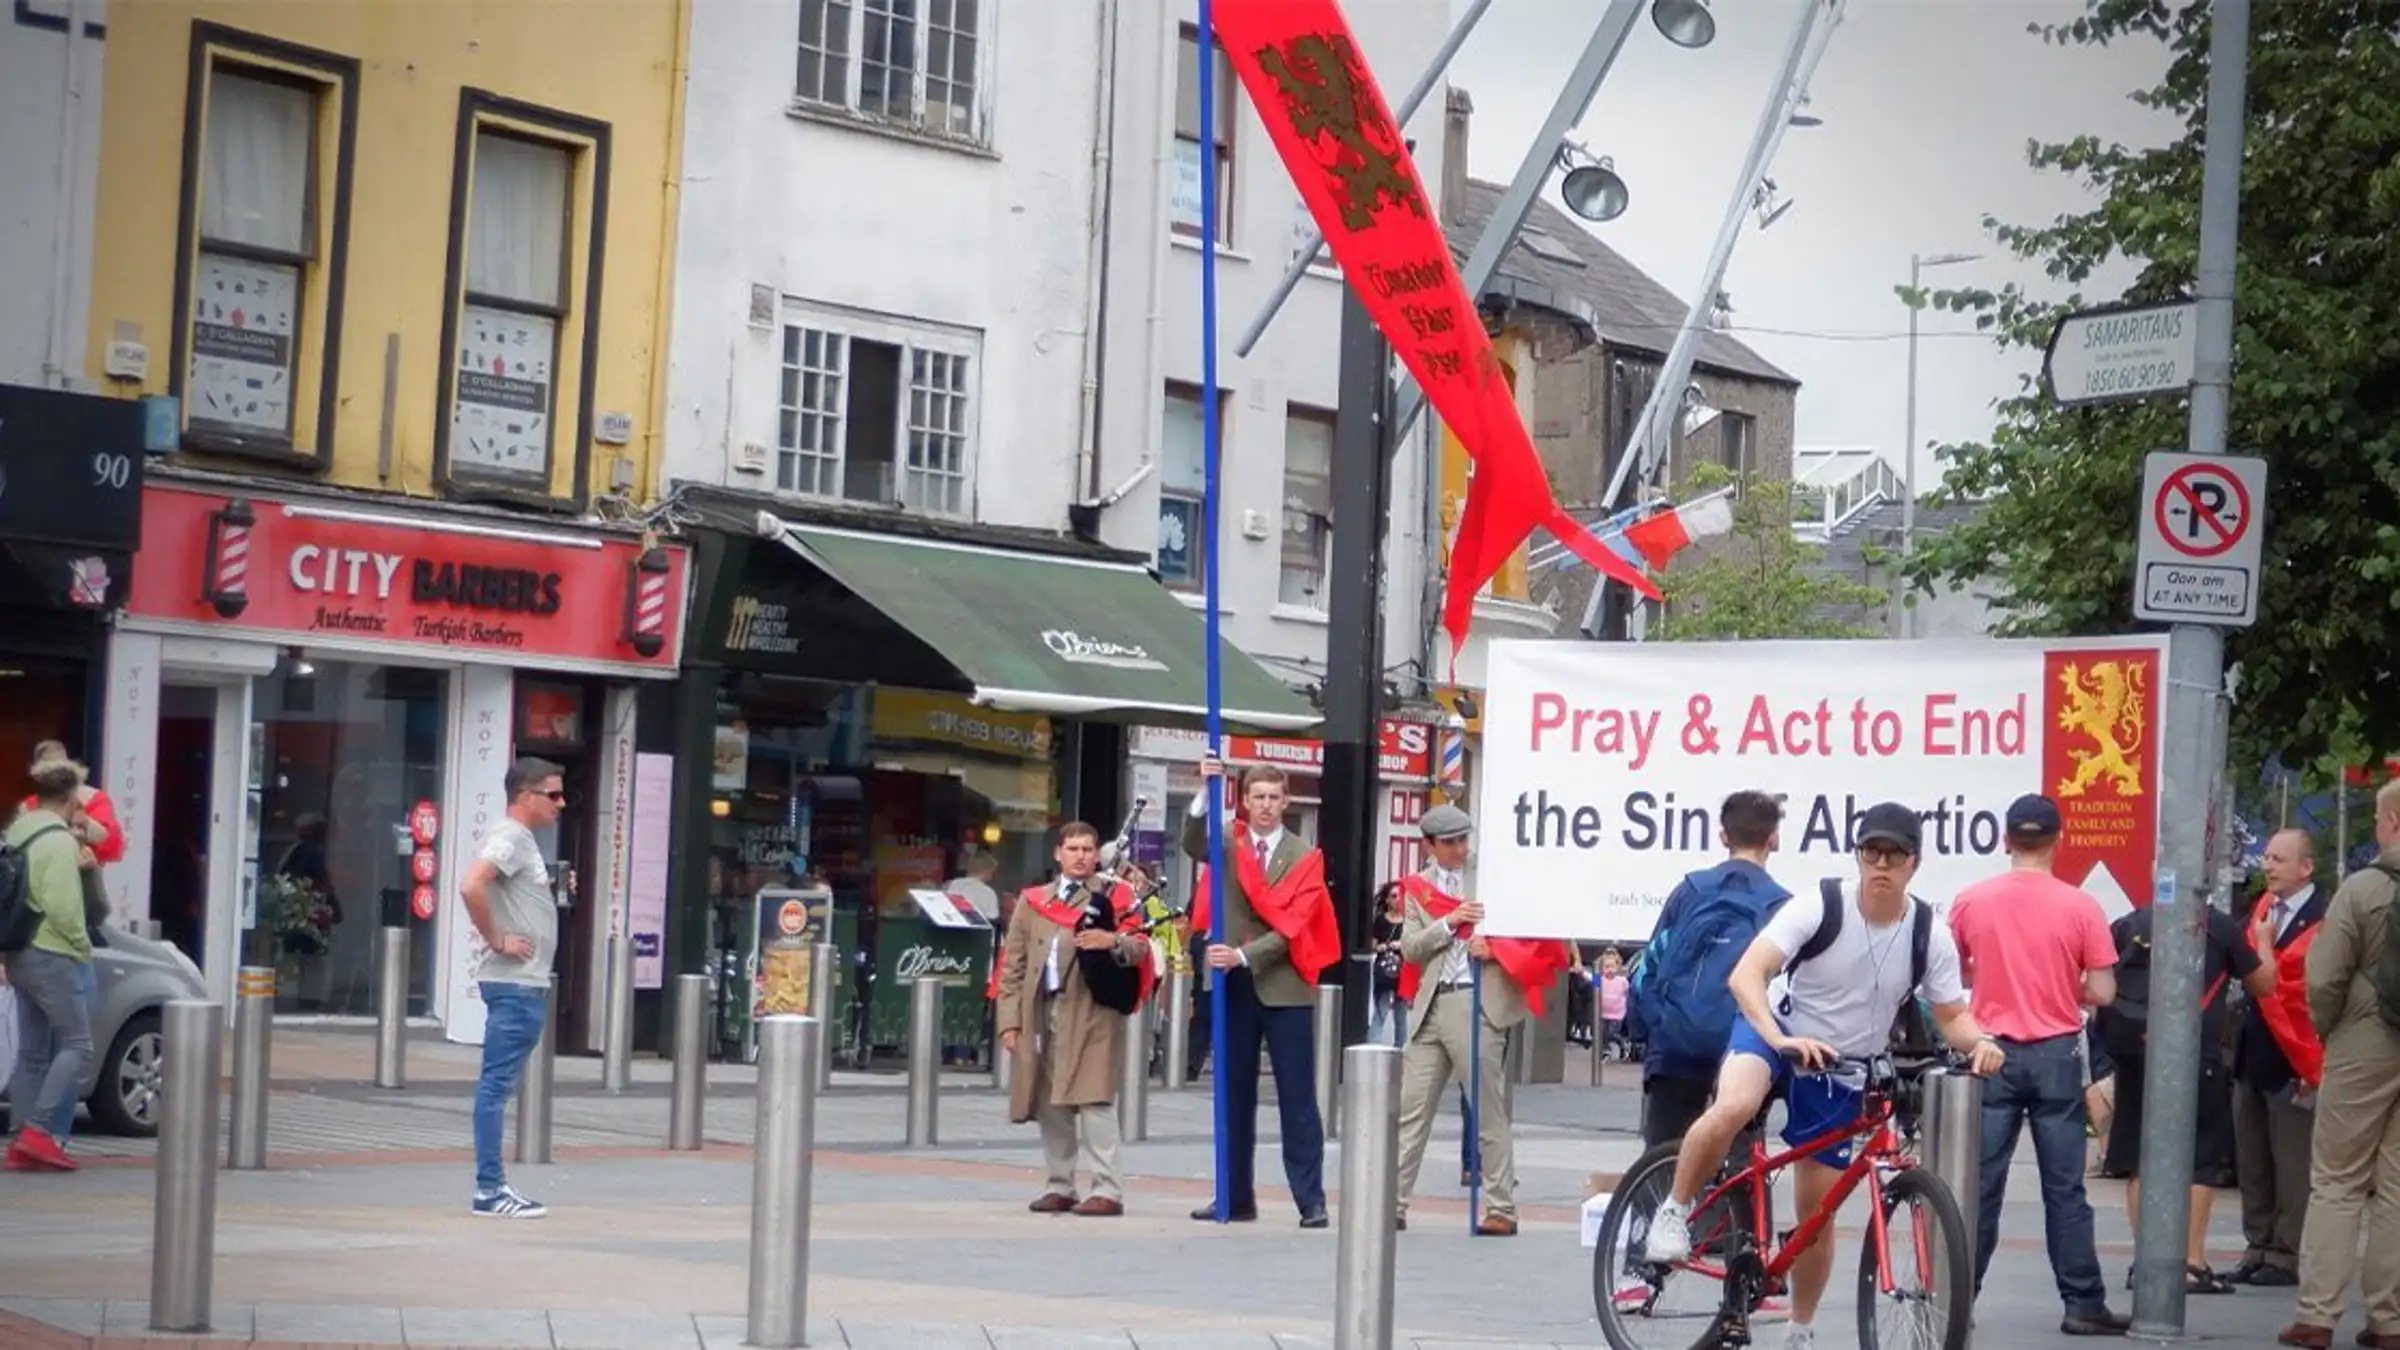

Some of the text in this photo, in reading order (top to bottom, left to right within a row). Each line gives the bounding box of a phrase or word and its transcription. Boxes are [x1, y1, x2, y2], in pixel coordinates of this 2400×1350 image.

[2084, 309, 2183, 348] SAMARITANS
[2086, 367, 2116, 393] 1850
[94, 452, 130, 488] 90
[2188, 482, 2227, 537] P
[290, 544, 562, 618] CITY BARBERS
[2152, 589, 2240, 608] AT ANY TIME
[309, 606, 523, 647] Authentic Turkish Barbers
[1531, 692, 2026, 770] Pray & Act to End
[1254, 740, 1313, 762] TURKISH
[1514, 789, 1601, 849] the
[1622, 791, 1709, 850] Sin
[1799, 794, 2010, 855] Abrtio
[2066, 817, 2136, 830] FAMILY AND
[2070, 801, 2132, 813] TRADITION
[2069, 834, 2128, 847] PROPERTY
[896, 943, 972, 977] O'Briens
